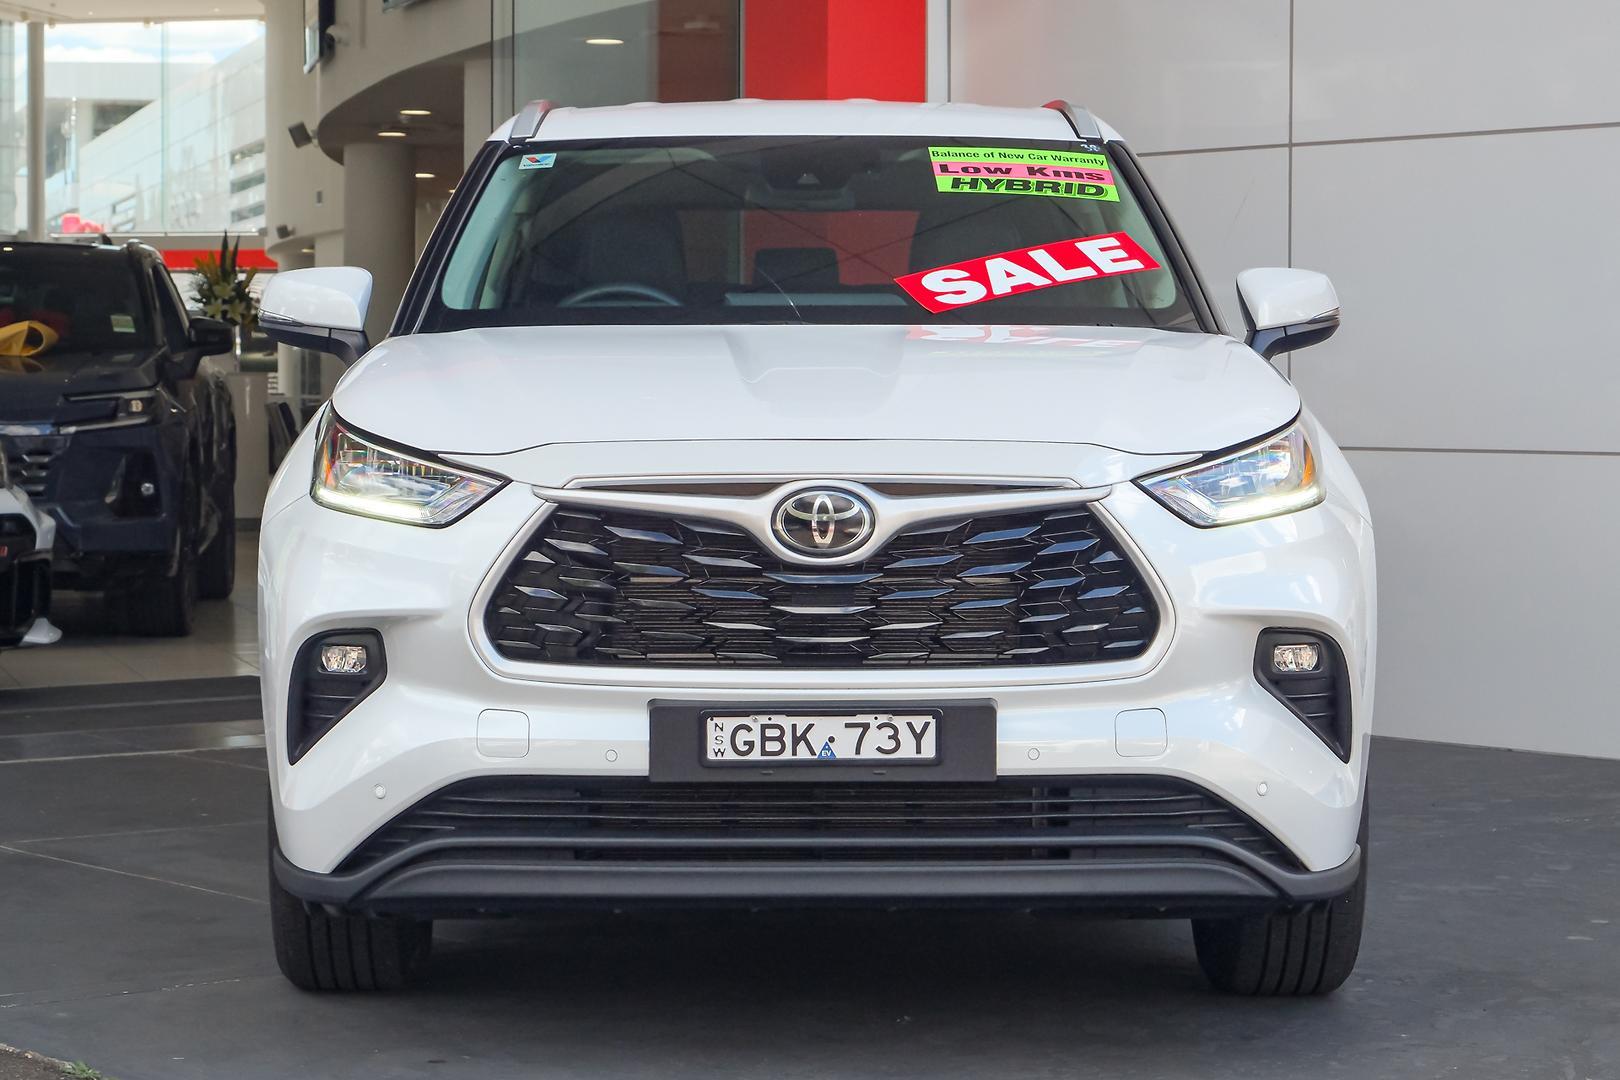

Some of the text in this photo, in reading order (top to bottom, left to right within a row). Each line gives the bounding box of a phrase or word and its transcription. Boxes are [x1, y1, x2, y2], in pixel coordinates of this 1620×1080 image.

[931, 150, 980, 158] Balance
[1028, 153, 1048, 161] Car
[1050, 154, 1105, 166] Warranty
[939, 164, 1105, 181] Low Kms
[951, 177, 1108, 198] HYBRID
[921, 236, 1145, 305] SALE
